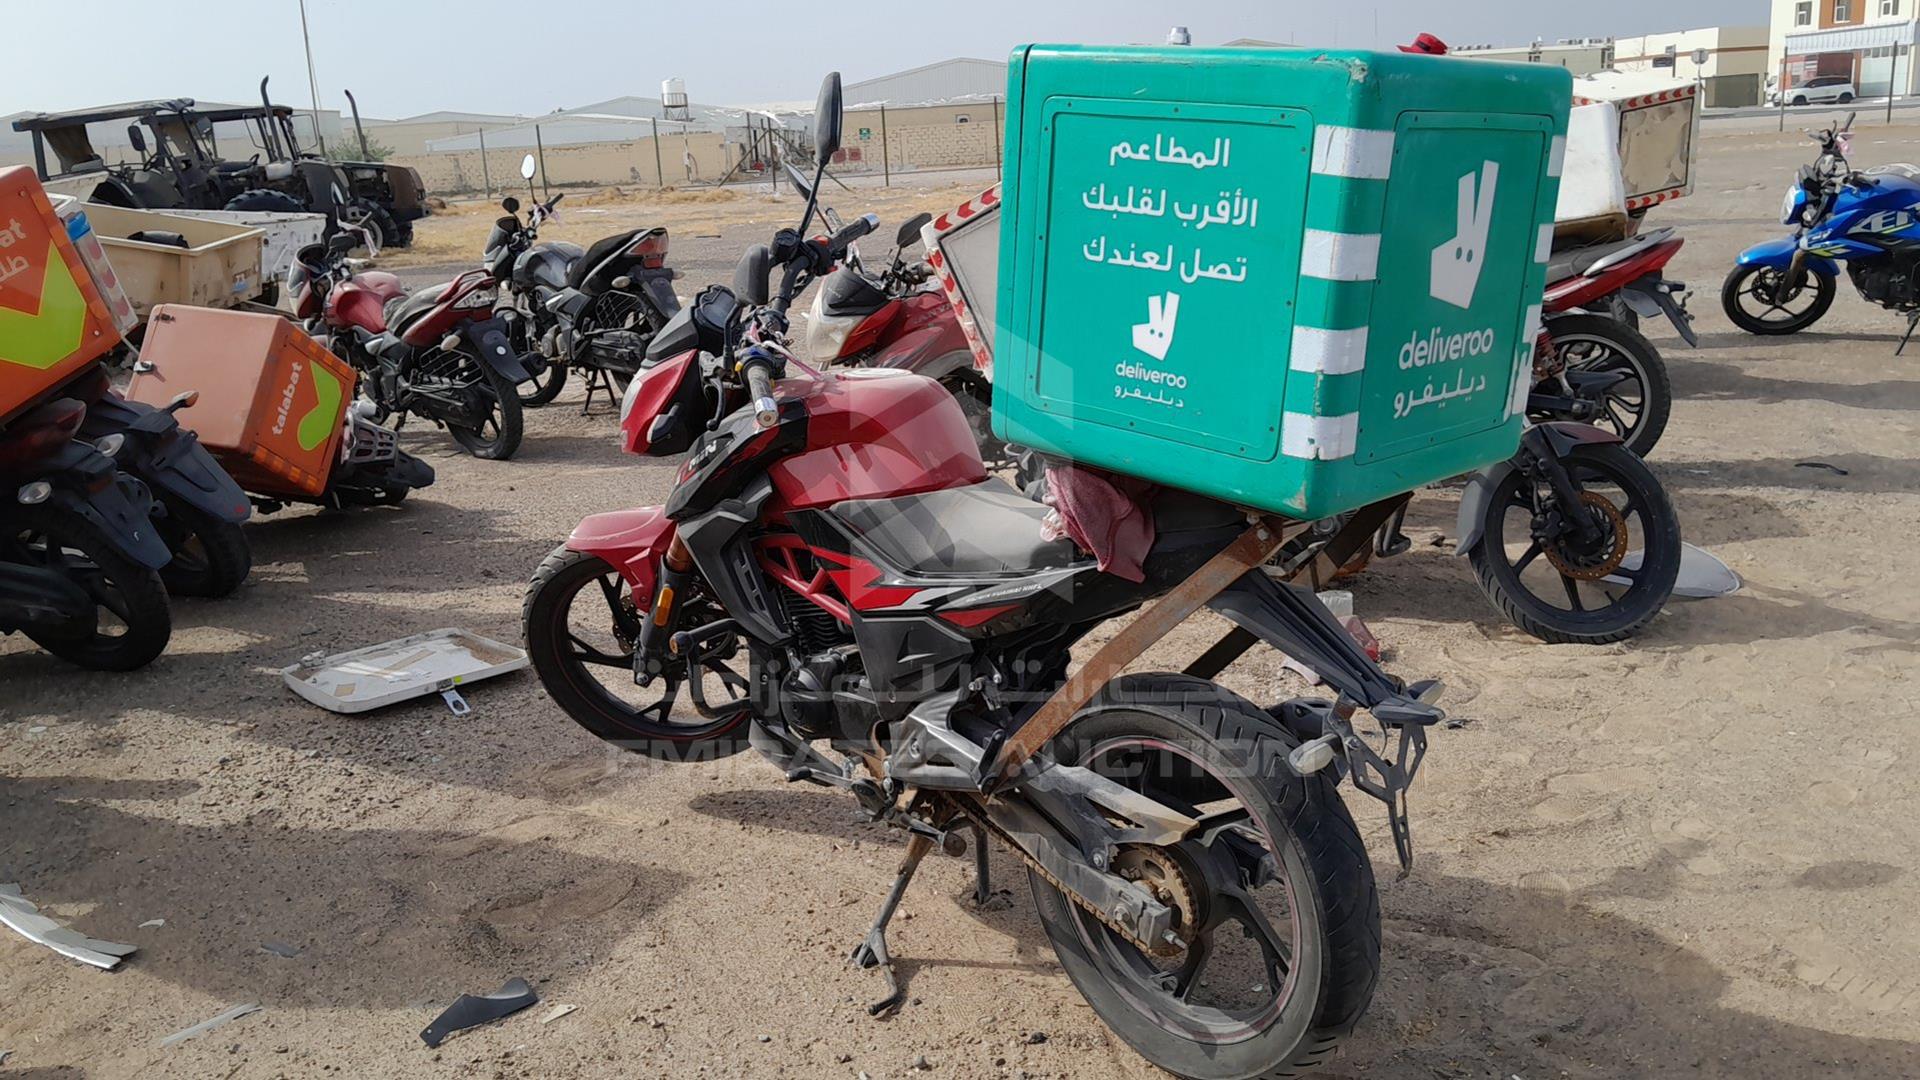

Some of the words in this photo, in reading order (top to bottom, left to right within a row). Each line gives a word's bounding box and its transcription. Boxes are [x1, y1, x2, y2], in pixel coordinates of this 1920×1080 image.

[1109, 132, 1231, 169] المطاعم
[1081, 182, 1168, 220] لقلبك
[1173, 187, 1259, 230] الأقرب
[1082, 235, 1175, 272] لعندك
[1179, 247, 1248, 284] تصل
[1398, 326, 1495, 371] deliveroo
[1115, 359, 1188, 390] deliveroo
[271, 361, 303, 436] talabat
[1114, 384, 1185, 412] ديليفرو
[1393, 367, 1487, 420] ديليفرو
